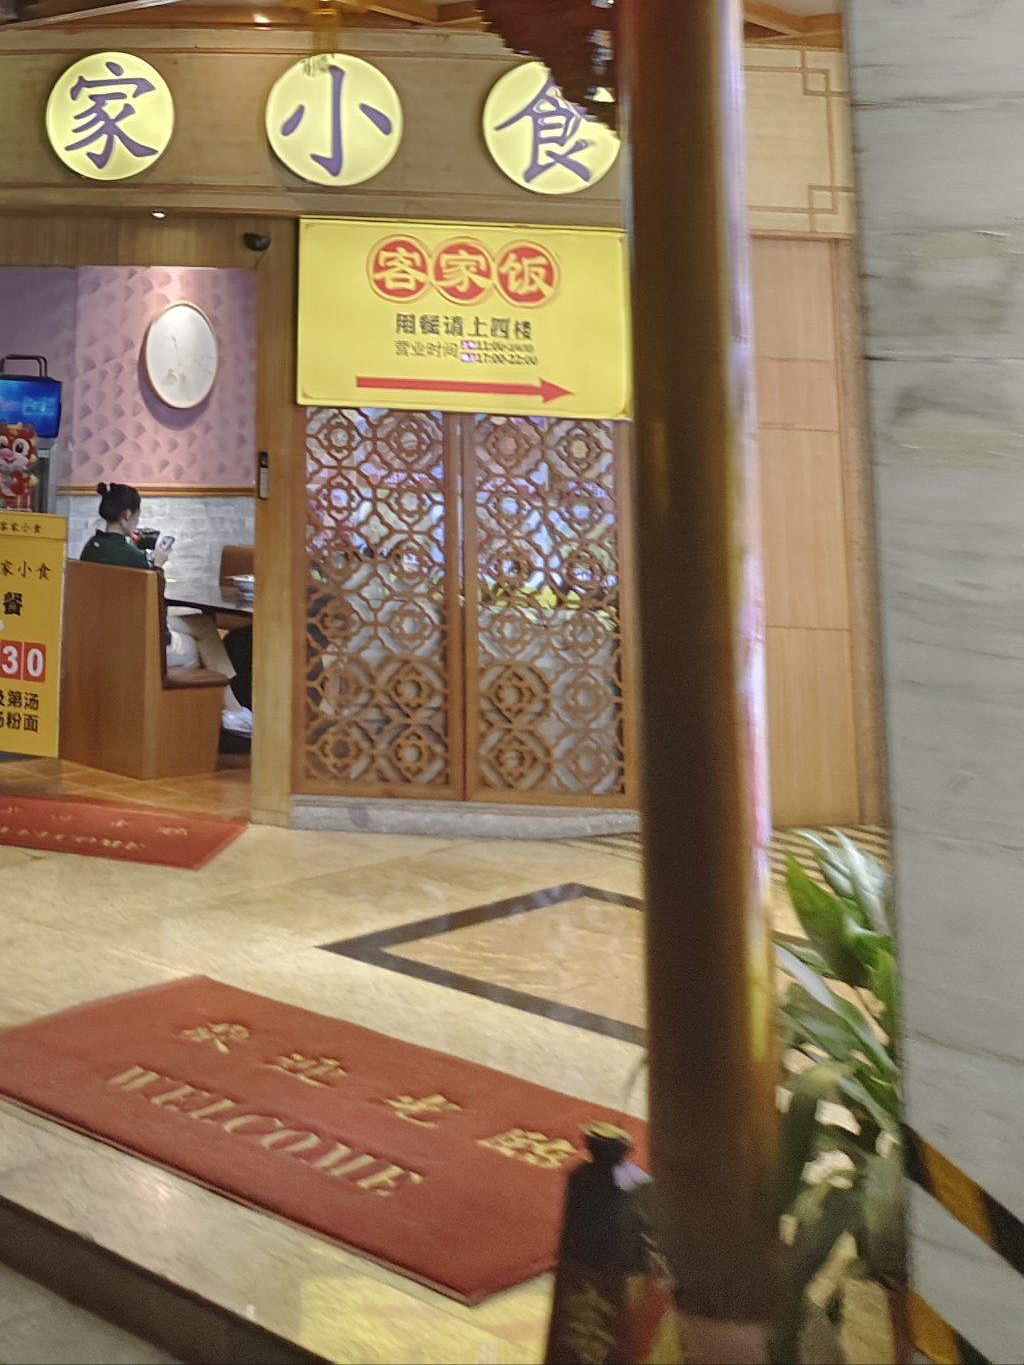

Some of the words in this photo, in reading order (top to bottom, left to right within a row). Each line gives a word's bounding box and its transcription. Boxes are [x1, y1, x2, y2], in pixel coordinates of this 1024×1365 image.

[371, 246, 553, 299] 客家饭
[395, 313, 532, 340] 用餐请上四楼
[108, 1065, 425, 1197] WELCOME
